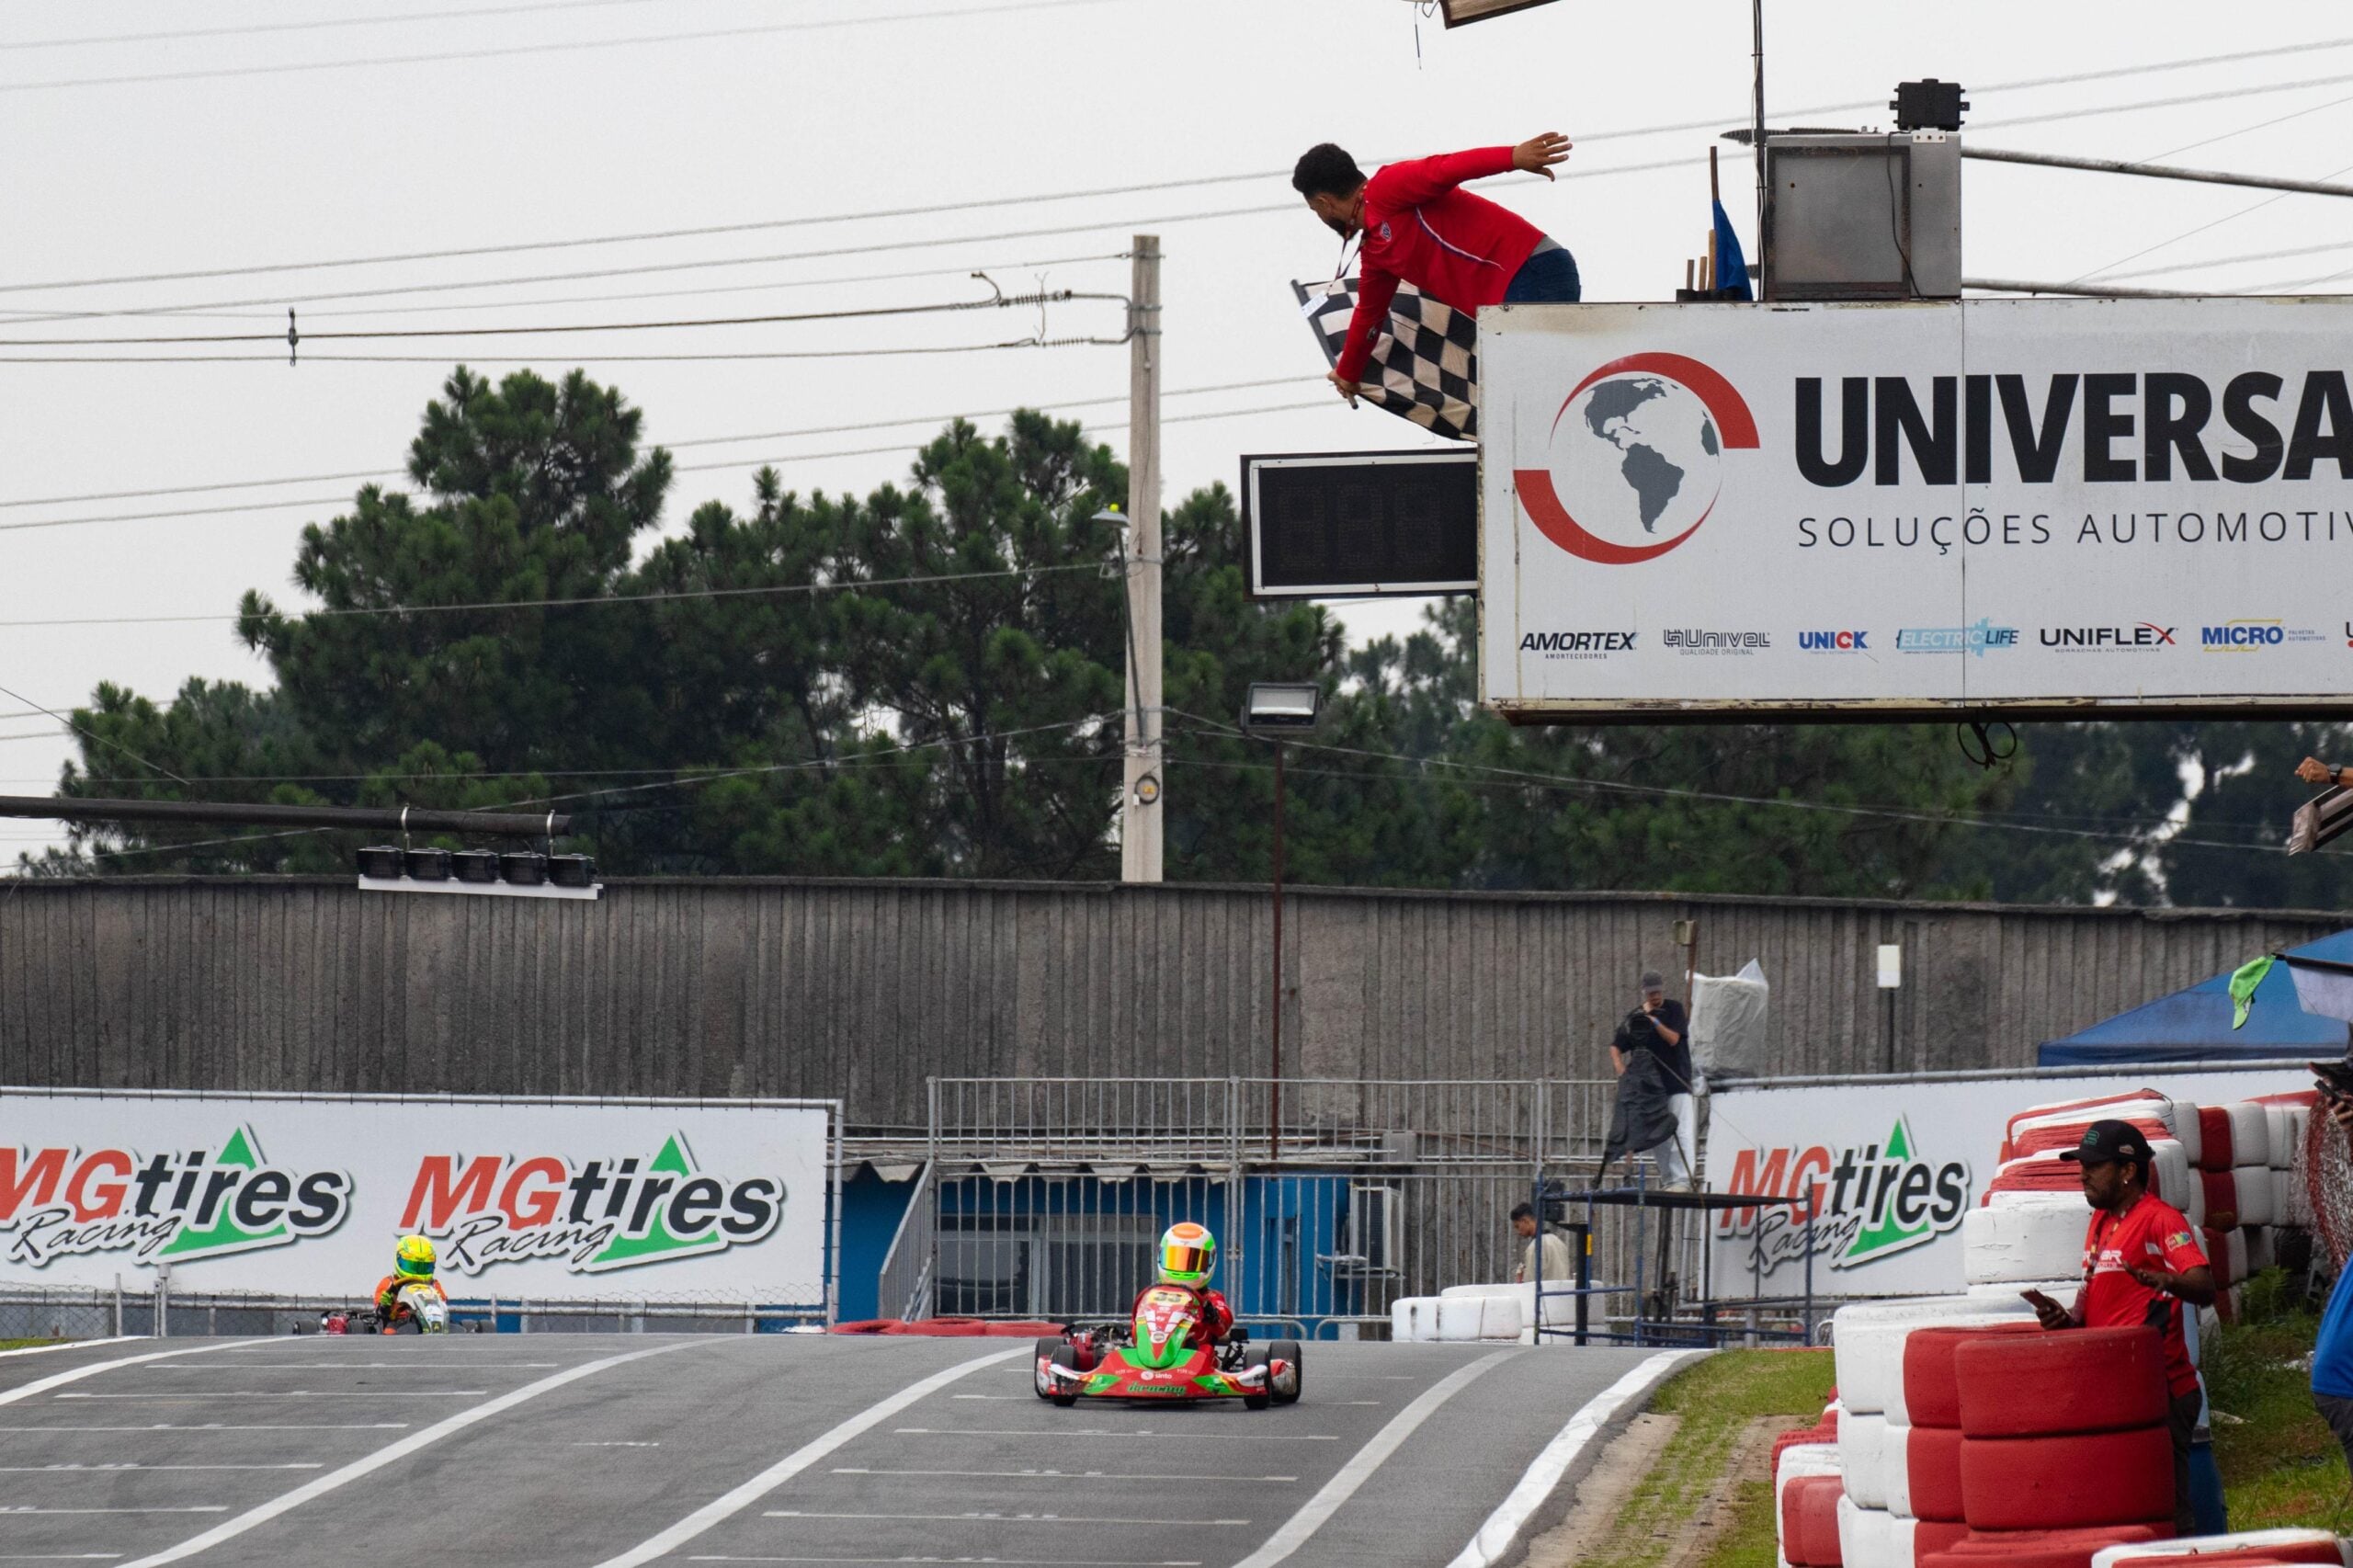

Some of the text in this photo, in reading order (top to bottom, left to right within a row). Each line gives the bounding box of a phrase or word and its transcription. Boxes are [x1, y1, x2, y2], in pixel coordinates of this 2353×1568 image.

[1798, 507, 2353, 555] SOLUÇÕES AUTOMOTI
[1519, 631, 1637, 651] AMORTEX
[1799, 631, 1869, 649] UNICK
[2040, 627, 2177, 646] UNIFLEX
[2201, 626, 2284, 645] MICRO
[11, 1208, 182, 1259] Racing
[445, 1215, 614, 1265] Racing
